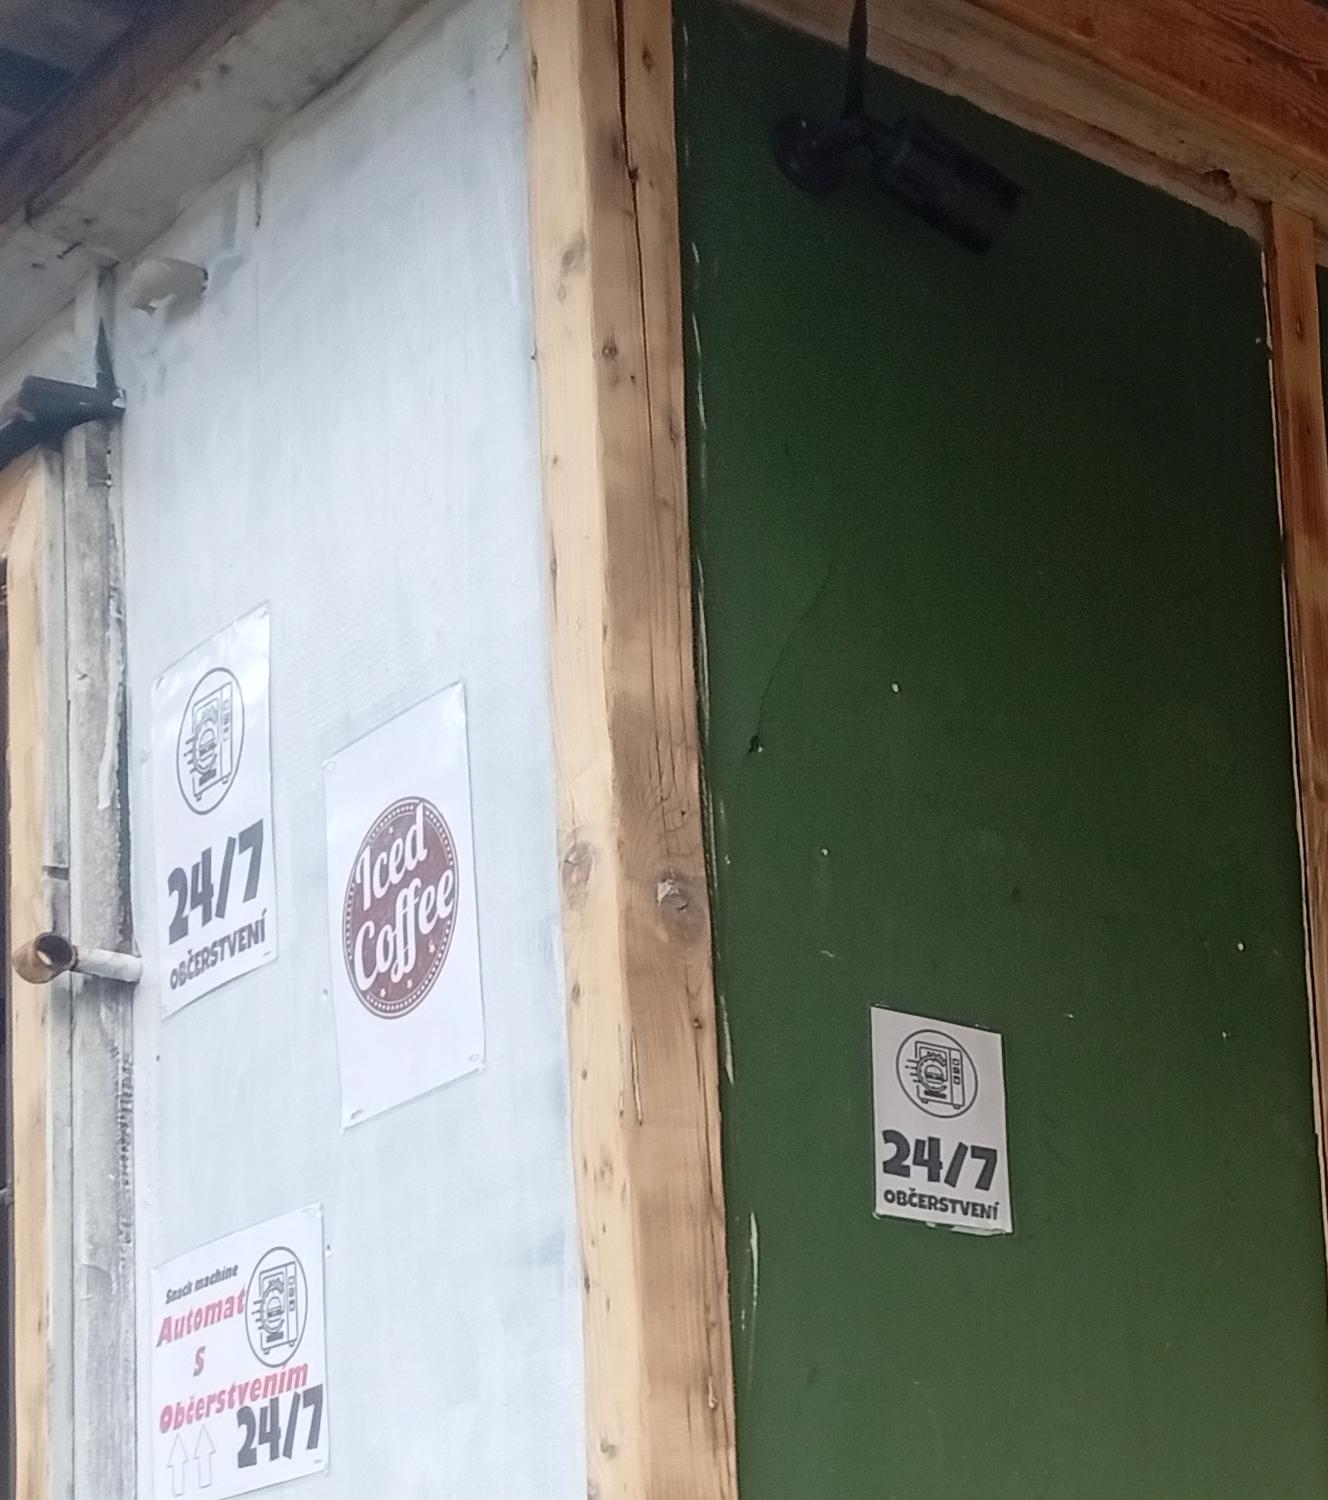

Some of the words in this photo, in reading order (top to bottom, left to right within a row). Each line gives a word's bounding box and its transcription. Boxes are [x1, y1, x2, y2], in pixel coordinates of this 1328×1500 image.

[167, 818, 264, 945] 24/7
[355, 802, 428, 911] Iced
[169, 908, 268, 990] OBČERSTVENÍ
[352, 869, 455, 991] Coffee
[881, 1129, 998, 1191] 24/7
[883, 1187, 1000, 1220] OBČERSTVENÍ
[156, 1285, 246, 1348] Automat
[194, 1264, 239, 1292] machine
[236, 1383, 324, 1469] 24/7
